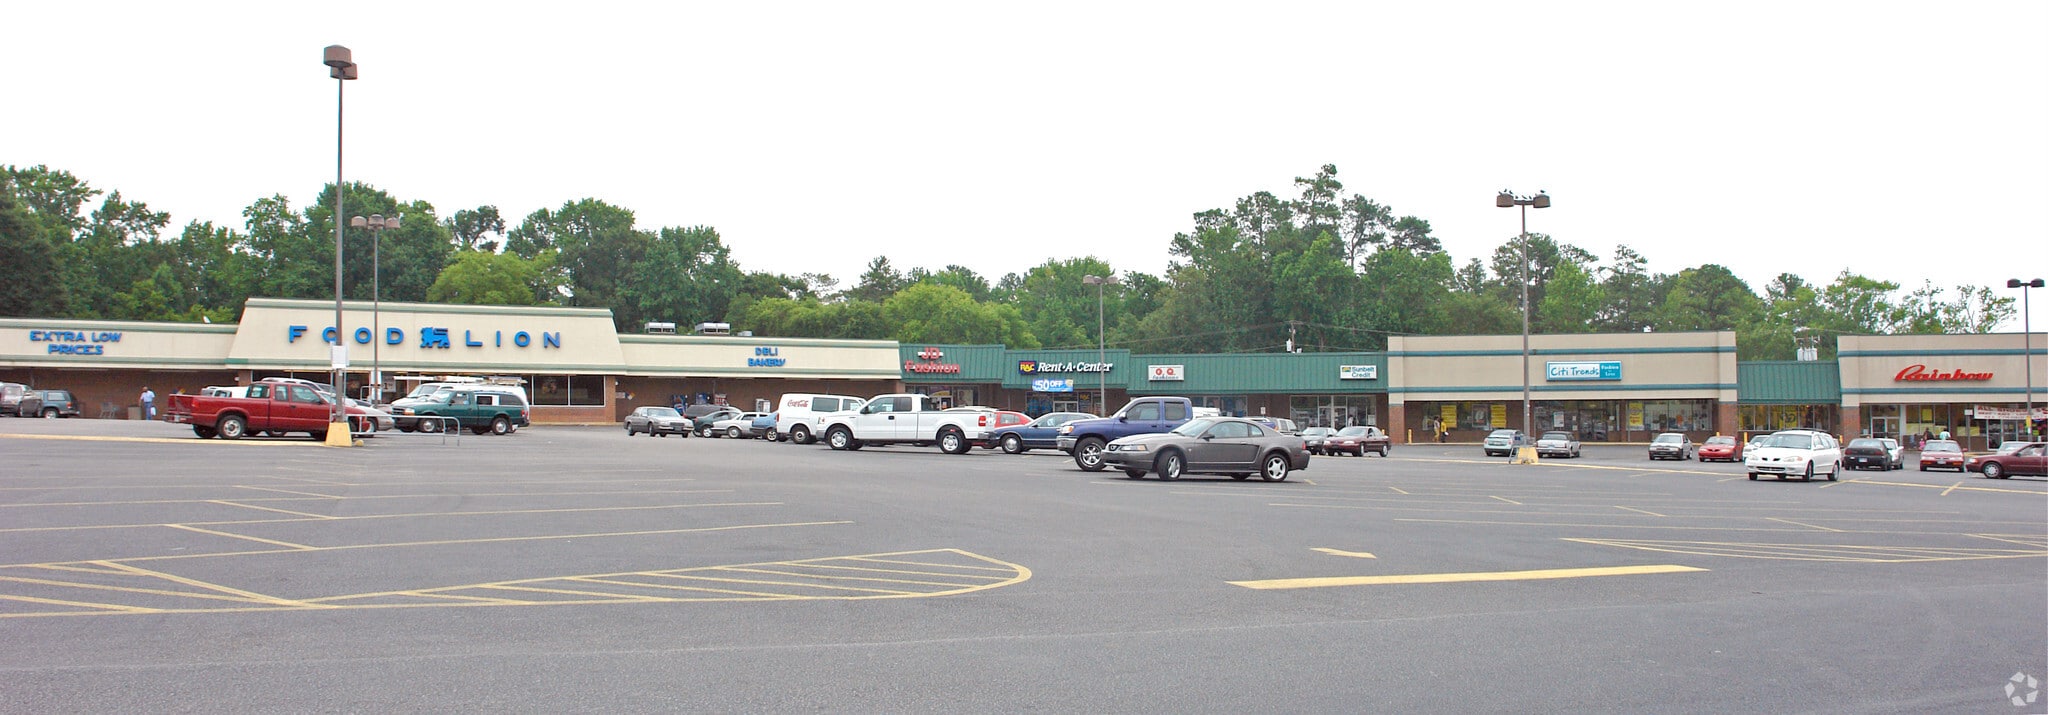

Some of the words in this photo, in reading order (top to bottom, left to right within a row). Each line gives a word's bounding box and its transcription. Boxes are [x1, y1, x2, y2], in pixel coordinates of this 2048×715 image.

[30, 330, 86, 342] EXTRA
[91, 332, 122, 342] LOW
[289, 325, 404, 345] FOOD
[465, 329, 561, 348] LION
[48, 344, 104, 355] PRICES
[755, 347, 778, 356] DELI
[921, 347, 940, 360] JD
[748, 358, 786, 367] BAKERY
[905, 361, 960, 374] Fashion
[1020, 364, 1035, 372] RAC
[1551, 367, 1568, 376] Citi
[1571, 366, 1599, 376] Trends
[1895, 364, 1993, 382] Rainbow
[1049, 380, 1064, 388] OFF
